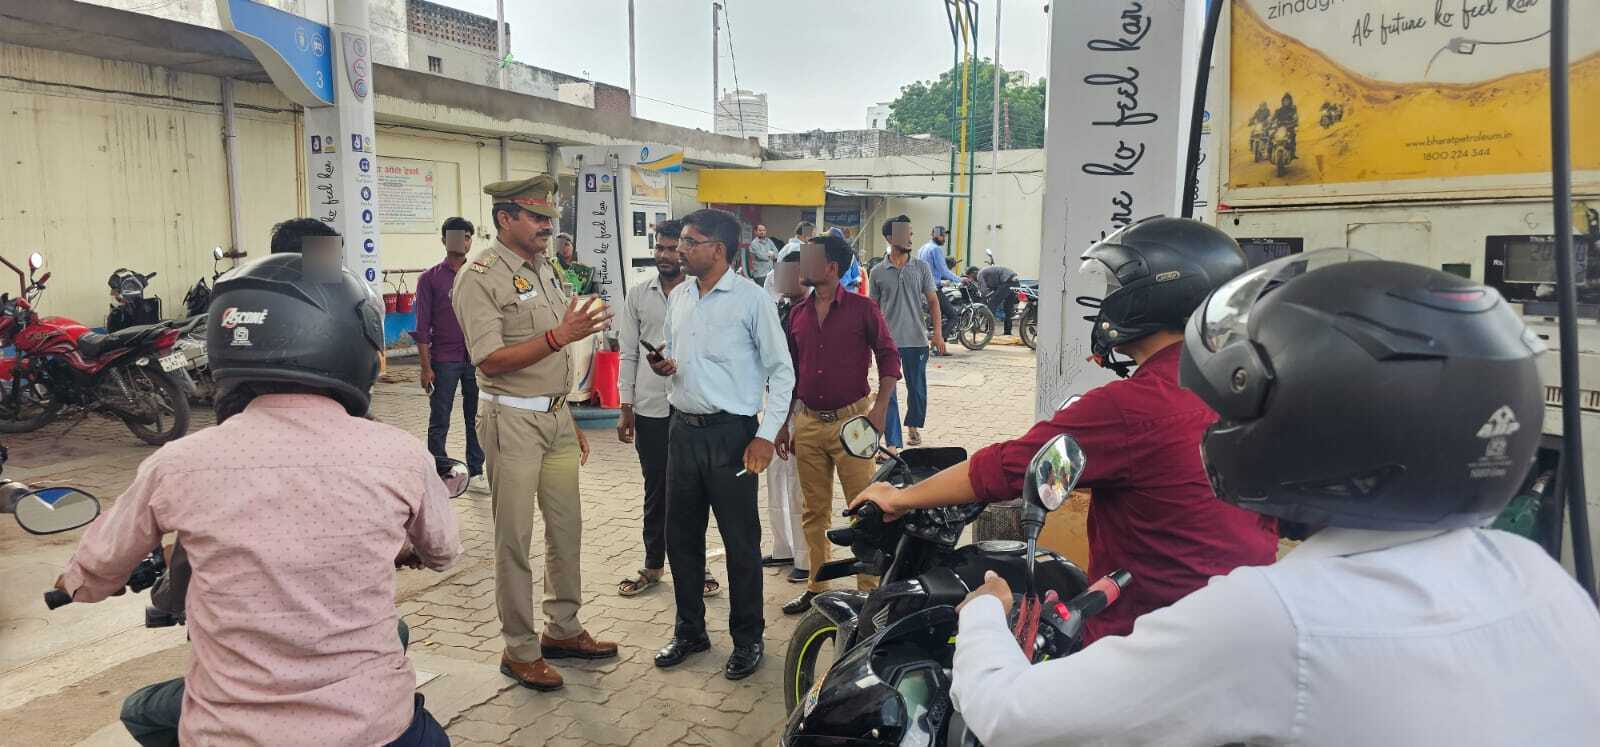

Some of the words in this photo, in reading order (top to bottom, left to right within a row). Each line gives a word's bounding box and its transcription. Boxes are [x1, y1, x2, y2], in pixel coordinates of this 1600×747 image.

[1086, 2, 1152, 51] kar
[1352, 12, 1374, 46] Ab
[1380, 12, 1426, 45] future
[1434, 0, 1454, 27] ko
[1463, 0, 1497, 30] feel
[315, 70, 325, 90] 3
[1083, 66, 1159, 127] feel
[1081, 140, 1145, 176] ko
[1423, 151, 1449, 161] 1800
[1451, 150, 1469, 160] 224
[592, 242, 609, 254] ko
